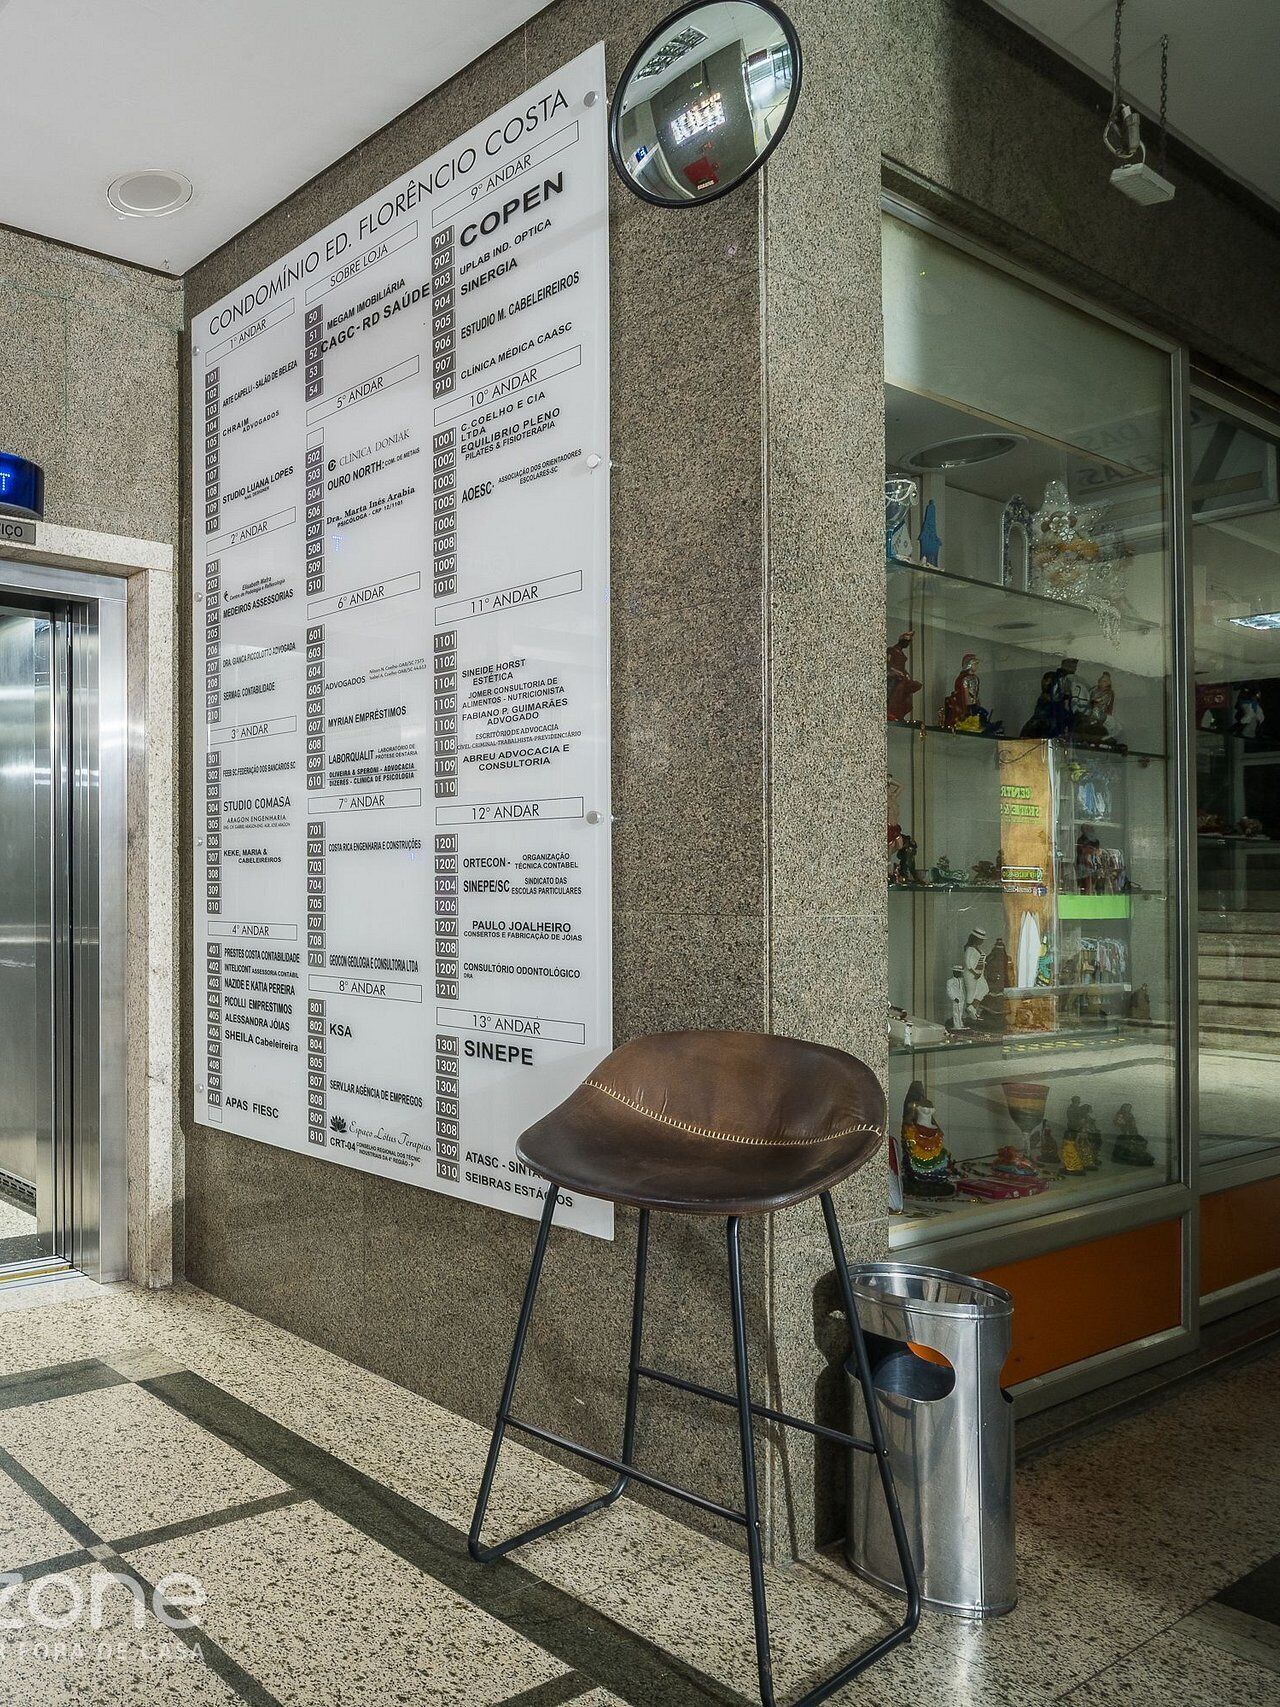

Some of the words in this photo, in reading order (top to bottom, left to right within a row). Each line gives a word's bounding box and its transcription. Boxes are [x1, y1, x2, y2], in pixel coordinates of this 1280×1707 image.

[486, 154, 531, 191] ANDAR
[209, 251, 319, 334] CONDOMÍNIO
[326, 232, 351, 261] ED.
[359, 148, 476, 239] FLORÊNCIO
[485, 90, 567, 155] COSTA
[460, 172, 562, 246] COPEN
[434, 229, 449, 249] 901
[459, 252, 490, 275] UPLAB
[492, 241, 511, 257] IND.
[514, 218, 551, 244] OPTICA
[330, 259, 360, 286] SOBRE
[363, 243, 387, 266] LOJA
[434, 272, 449, 290] 903
[460, 258, 517, 295] SINERGIA
[327, 307, 354, 330] MEGAM
[356, 278, 405, 313] IMOBILIÁRIA
[383, 282, 429, 318] SAÚDE
[461, 313, 495, 339] ESTUDIO
[497, 308, 506, 321] M.
[508, 271, 579, 315] CABELEIREIROS
[238, 318, 266, 343] ANDAR
[435, 334, 450, 352] 906
[460, 357, 496, 379] CLÍNICA
[498, 339, 534, 362] MÉDICA
[537, 321, 572, 344] CAASC
[309, 365, 317, 378] 53
[348, 376, 383, 402] ANDAR
[435, 376, 451, 393] 910
[492, 368, 537, 398] ANDAR
[222, 417, 248, 436] CHRAIM
[242, 410, 279, 432] ADVOGADOS
[461, 424, 519, 453] EQUILIBRIO
[523, 407, 559, 429] PLENO
[461, 426, 486, 442] LTDA
[433, 430, 453, 448] 1001
[465, 444, 493, 460] PILATES
[502, 420, 555, 446] FISIOTERAPIA
[307, 450, 320, 464] 502
[222, 487, 245, 504] STUDIO
[247, 476, 269, 493] LUANA
[270, 465, 293, 482] LOPES
[327, 473, 350, 490] OURO
[433, 473, 453, 490] 1003
[326, 515, 342, 524] Dra.
[344, 505, 367, 518] Marta
[387, 486, 415, 502] Arabia
[434, 494, 453, 511] 1005
[239, 520, 267, 540] ANDAR
[308, 542, 320, 555] 508
[308, 578, 320, 591] 510
[223, 602, 251, 618] MEDEIROS
[252, 588, 293, 608] ASSESSORIAS
[349, 585, 384, 605] ANDAR
[492, 585, 538, 608] ANDAR
[308, 628, 320, 640] 601
[308, 665, 320, 677] 604
[462, 664, 493, 678] SINEIDE
[496, 658, 525, 671] HORST
[325, 675, 365, 690] ADVOGADOS
[435, 675, 454, 690] 1104
[473, 671, 513, 685] ESTÉTICA
[468, 688, 491, 698] JOMER
[493, 679, 544, 694] CONSULTORIA
[462, 696, 501, 708] ALIMENTOS
[507, 686, 564, 700] NUTRICIONISTA
[328, 715, 353, 727] MYRIAN
[355, 705, 406, 722] EMPRÉSTIMOS
[462, 708, 499, 720] FABIANO
[511, 698, 568, 713] GUIMARÃES
[308, 720, 320, 732] 607
[435, 718, 454, 731] 1106
[487, 711, 539, 725] ADVOGADO
[240, 723, 268, 737] ANDAR
[328, 749, 373, 764] LABORQUALIT
[462, 752, 495, 762] ABREU
[498, 745, 559, 758] ADVOCACIA
[478, 757, 550, 771] CONSULTORIA
[308, 776, 320, 786] 610
[223, 799, 251, 811] STUDIO
[254, 796, 290, 809] COMASA
[350, 794, 384, 808] ANDAR
[494, 803, 539, 818] ANDAR
[436, 858, 455, 869] 1202
[522, 852, 570, 861] ORGANIZAÇÃO
[543, 860, 578, 868] CONTABEL
[435, 880, 455, 890] 1204
[463, 879, 509, 892] SINEPE/SC
[241, 925, 269, 936] ANDAR
[435, 921, 455, 932] 1207
[472, 920, 505, 930] PAULO
[509, 921, 571, 932] JOALHEIRO
[507, 931, 548, 940] FABRICAÇÃO
[244, 949, 260, 959] COSTA
[436, 962, 456, 975] 1209
[463, 962, 514, 973] CONSULTÓRIO
[516, 966, 580, 978] ODONTOLÓGICO
[250, 980, 267, 992] KATIA
[268, 982, 295, 995] PEREIRA
[350, 982, 385, 995] ANDAR
[248, 999, 292, 1014] EMPRESTIMOS
[309, 1002, 321, 1012] 801
[225, 1013, 268, 1027] ALESSANDRA
[494, 1018, 540, 1034] ANDAR
[329, 1023, 352, 1037] KSA
[224, 1029, 253, 1043] SHEILA
[255, 1035, 298, 1051] Cabeleireira
[437, 1038, 456, 1051] 1301
[464, 1040, 532, 1065] SINEPE
[437, 1080, 456, 1094] 1304
[225, 1096, 248, 1111] APAS
[252, 1102, 278, 1118] FIESC
[389, 1091, 422, 1107] EMPREGOS
[310, 1130, 322, 1142] 810
[330, 1136, 355, 1151] CRT-04
[436, 1142, 456, 1157] 1309
[465, 1151, 499, 1169] ATASC
[465, 1171, 511, 1192] SEIBRAS
